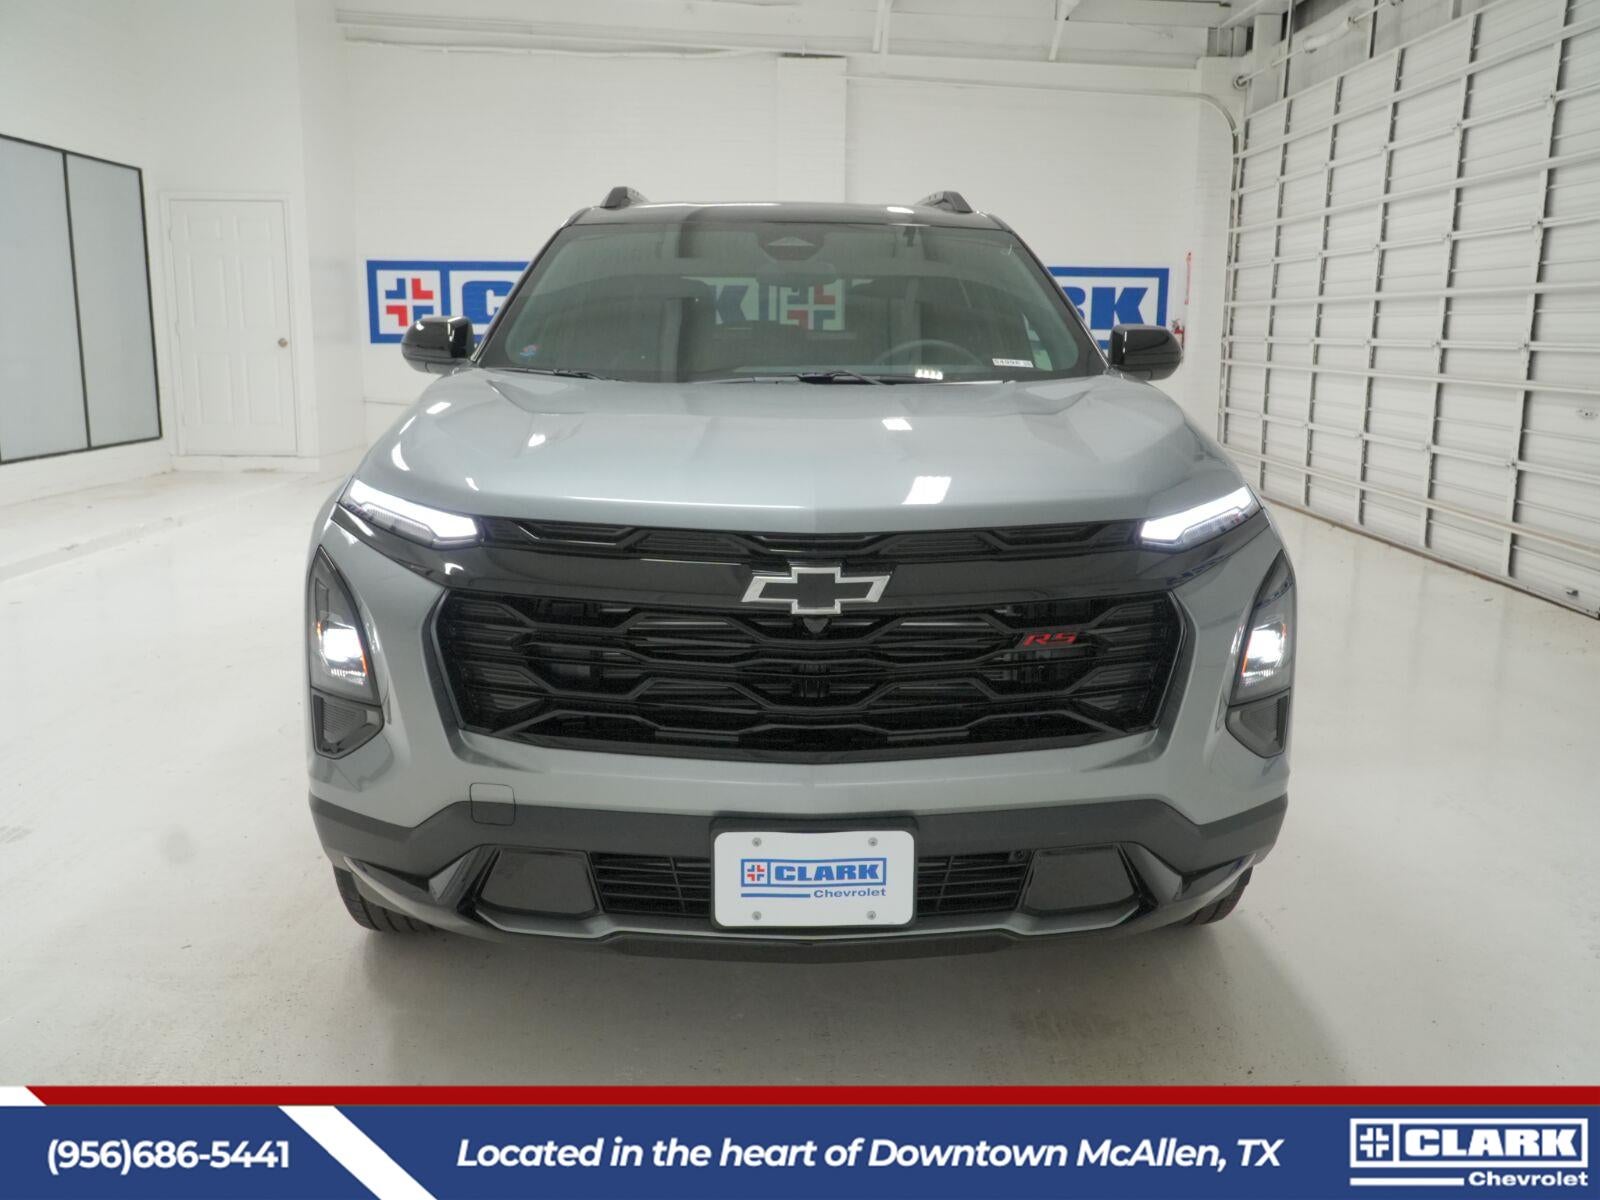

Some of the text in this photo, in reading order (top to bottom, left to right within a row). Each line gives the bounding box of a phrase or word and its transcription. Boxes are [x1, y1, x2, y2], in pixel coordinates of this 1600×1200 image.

[1023, 632, 1077, 647] RS
[774, 864, 880, 881] CLARK
[813, 888, 887, 898] Chevrolet
